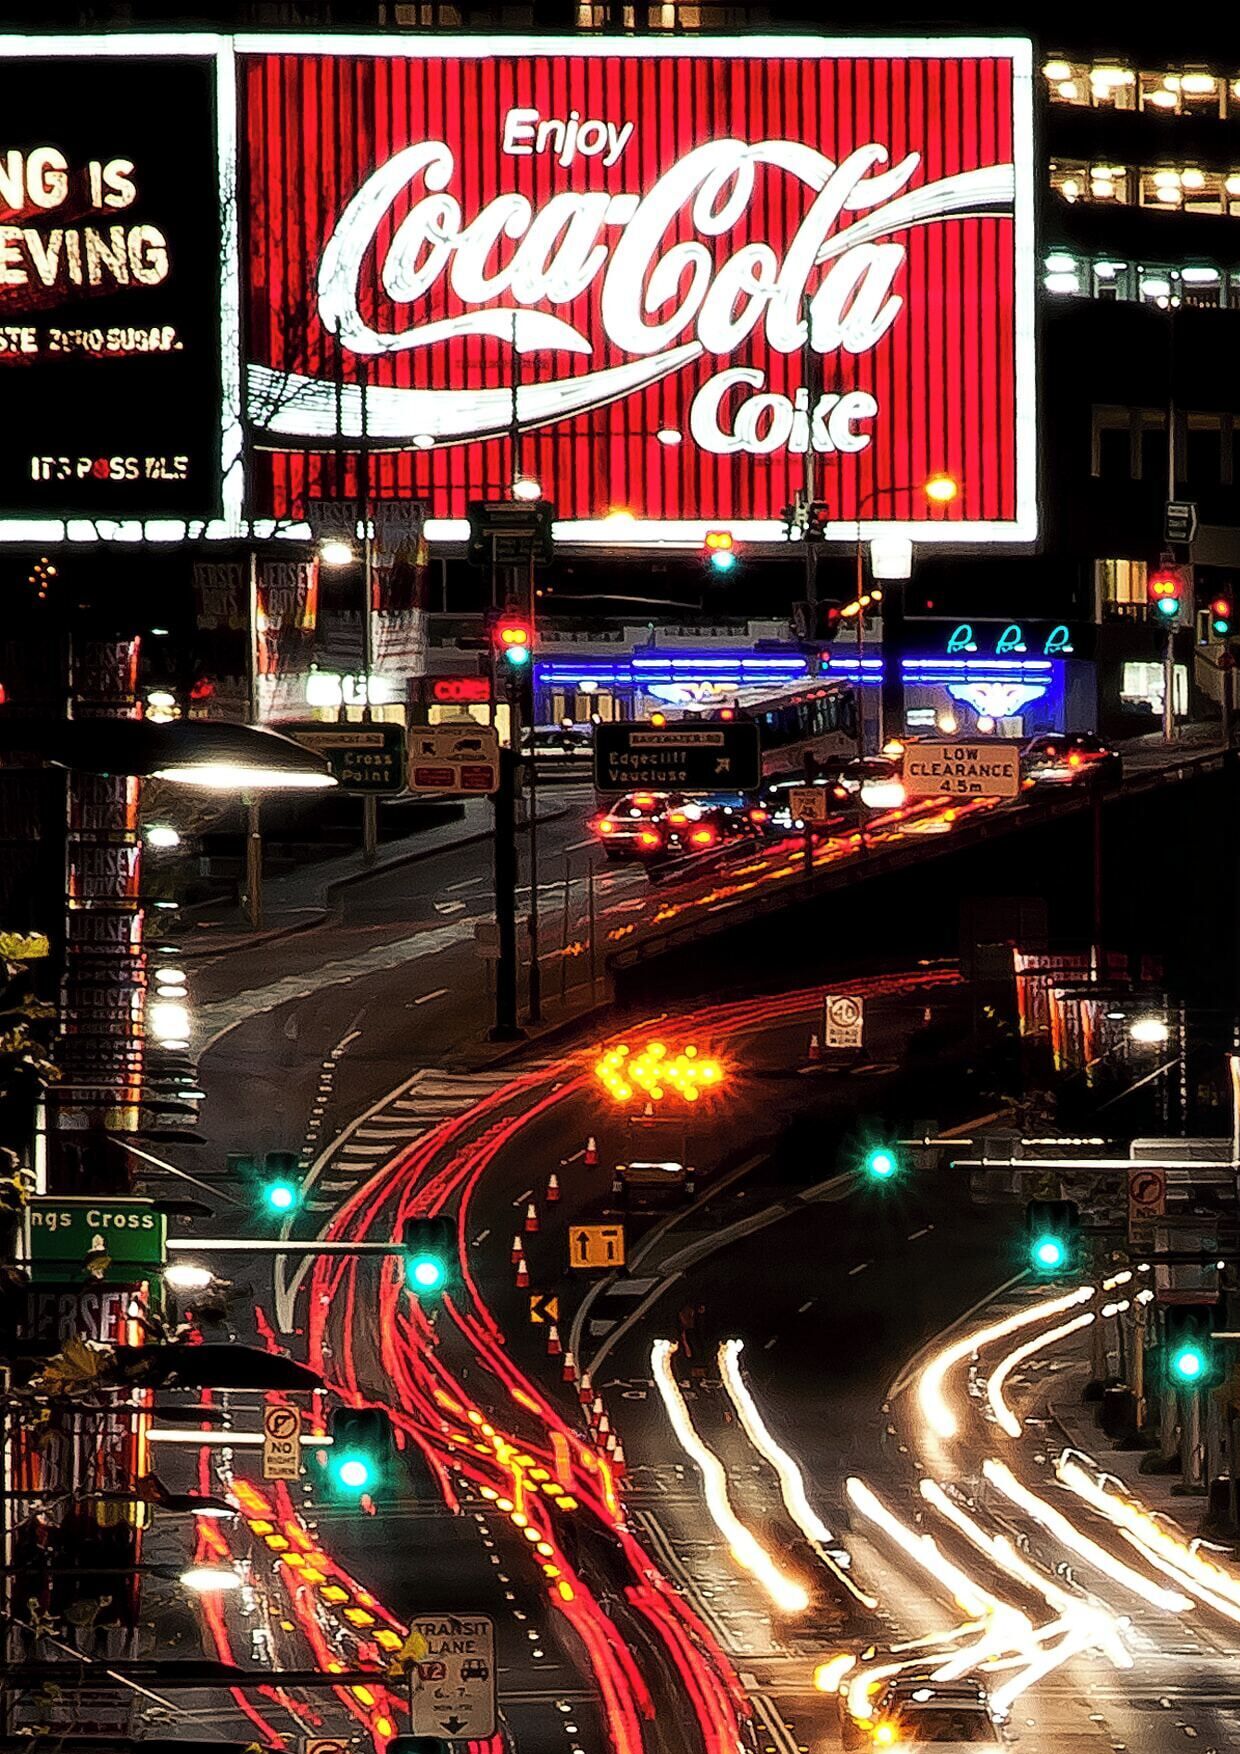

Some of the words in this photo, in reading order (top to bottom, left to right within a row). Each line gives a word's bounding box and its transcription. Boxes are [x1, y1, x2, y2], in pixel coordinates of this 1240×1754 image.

[503, 107, 634, 167] Enjoy
[88, 158, 137, 209] IS
[316, 138, 922, 356] Coca-Cola
[691, 366, 878, 454] Coke
[344, 753, 393, 765] Cross
[609, 752, 687, 768] Edgecliff
[943, 748, 978, 760] LOW
[609, 769, 687, 781] Vaucluse
[910, 763, 1013, 777] CLEARANCE
[86, 1209, 154, 1229] Cross
[271, 1442, 292, 1454] NO
[416, 1621, 490, 1636] TRANSIT
[428, 1640, 477, 1655] LANE
